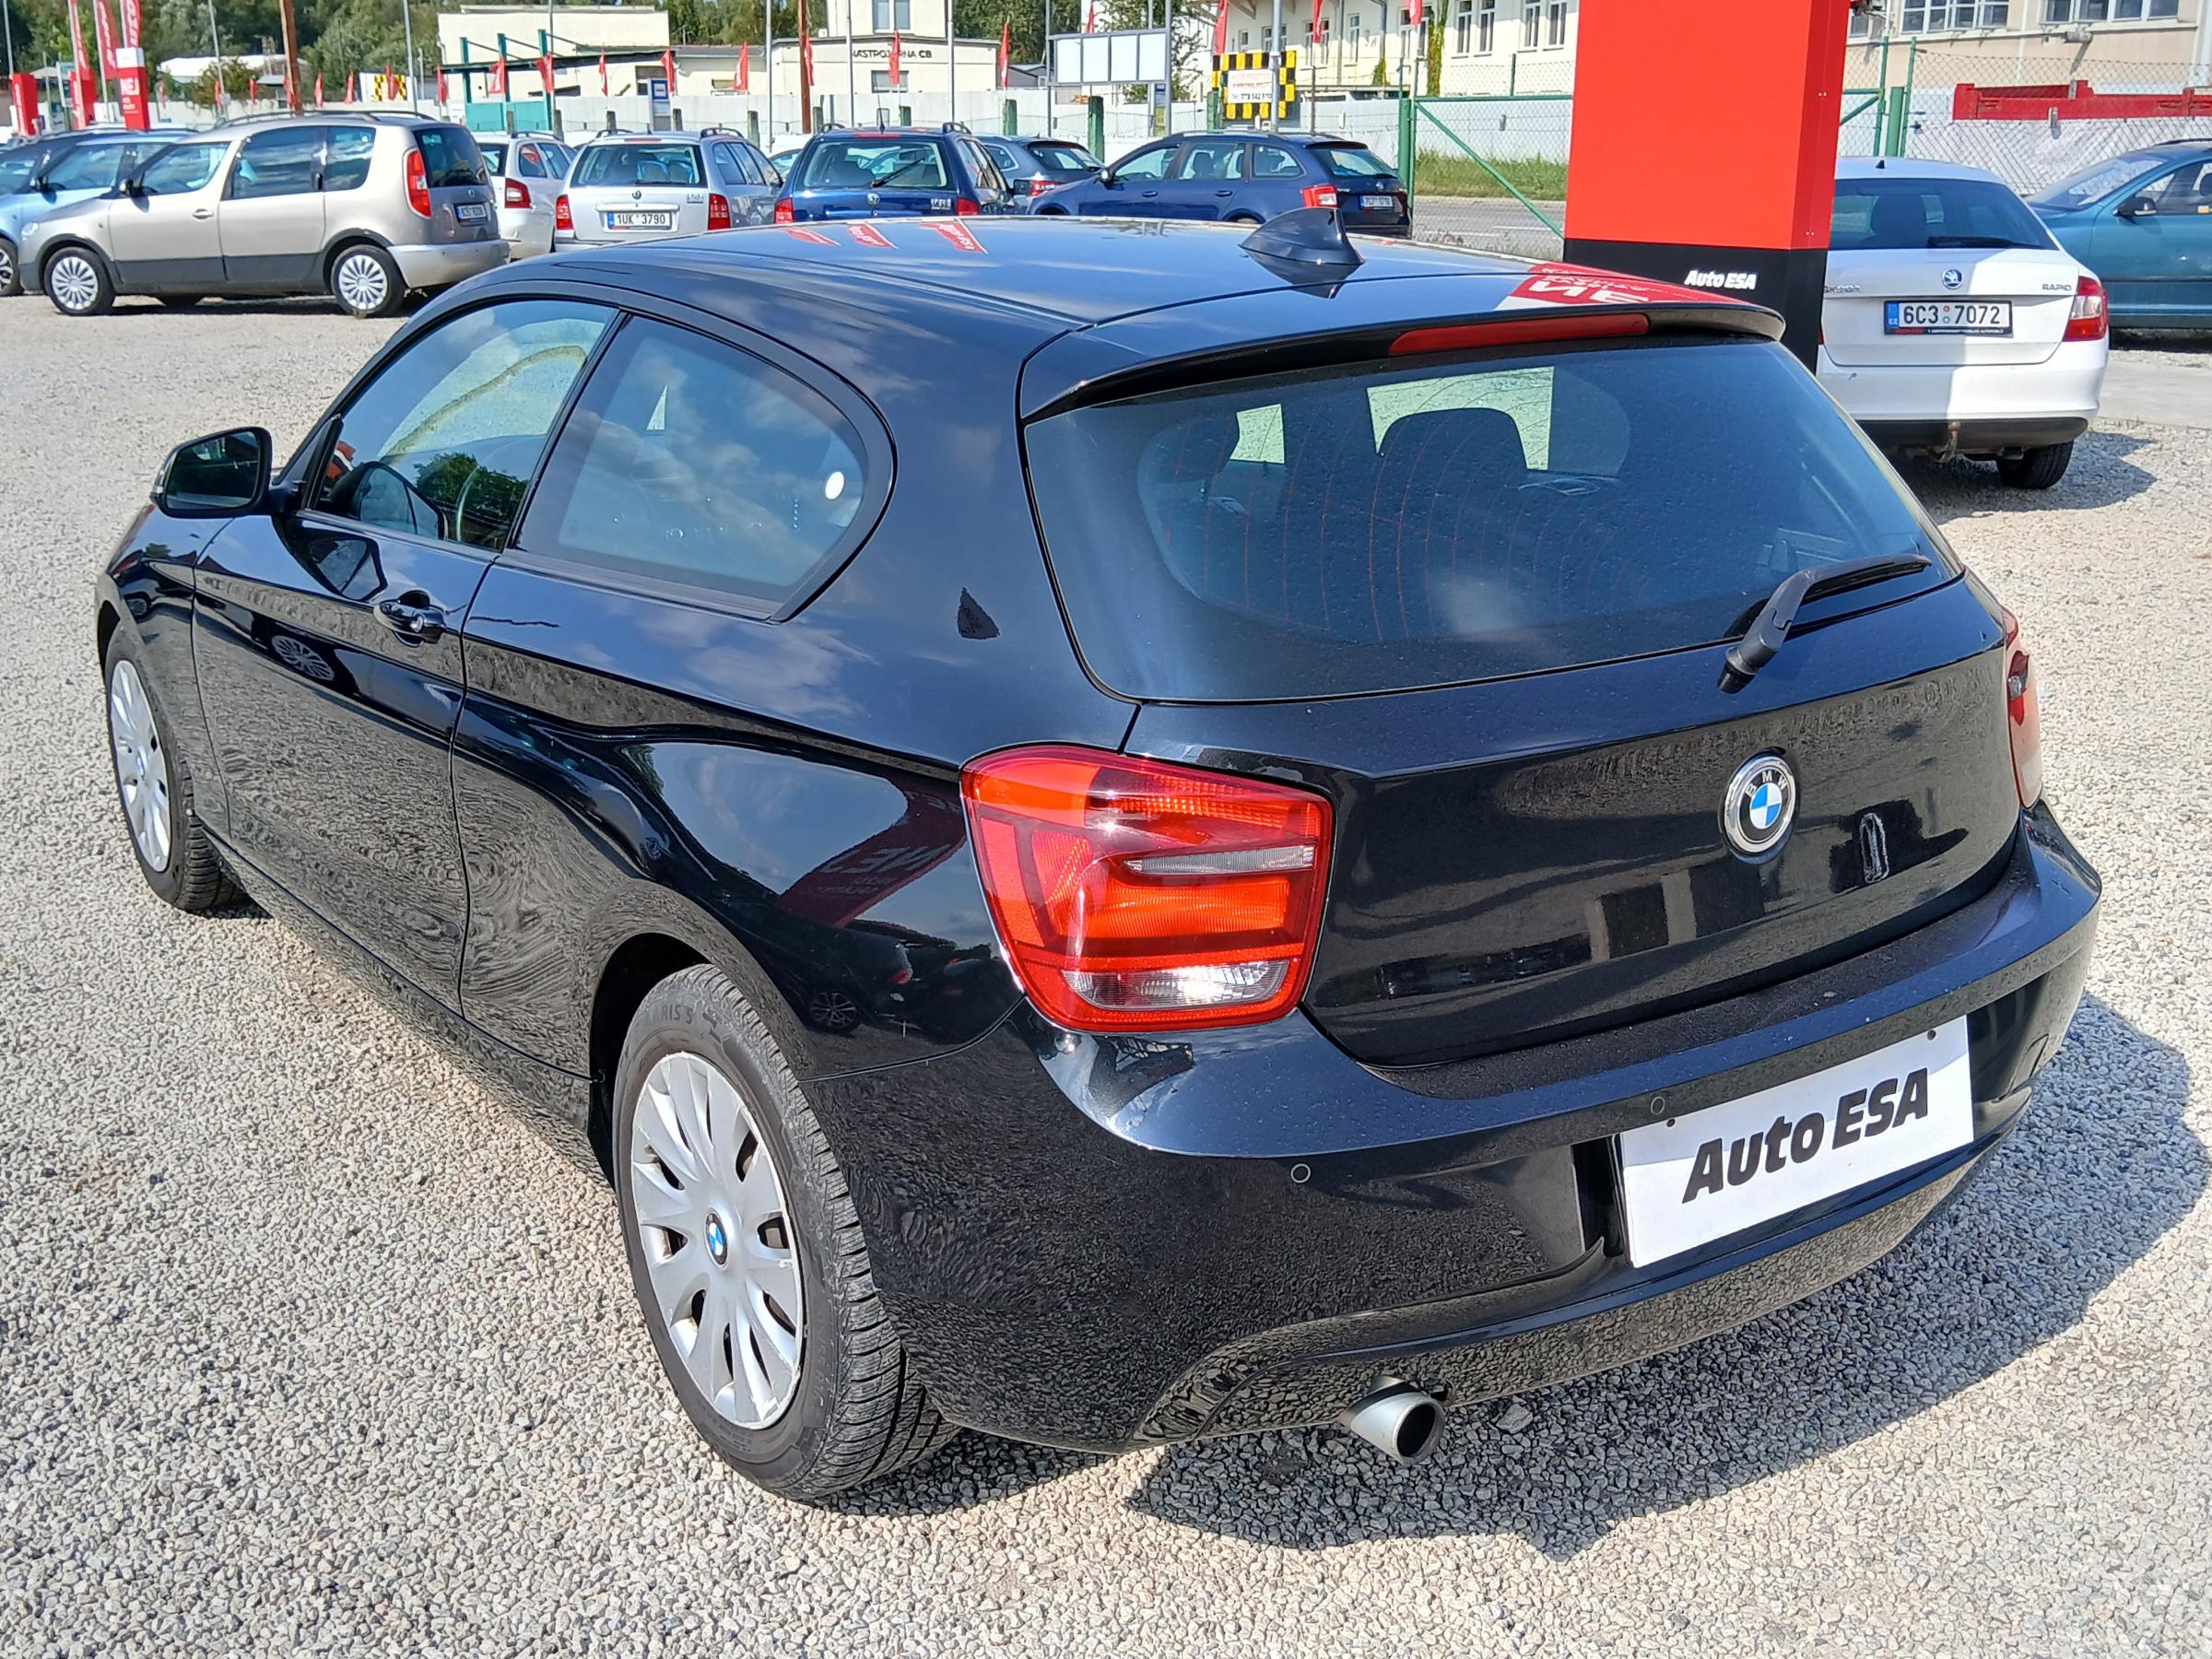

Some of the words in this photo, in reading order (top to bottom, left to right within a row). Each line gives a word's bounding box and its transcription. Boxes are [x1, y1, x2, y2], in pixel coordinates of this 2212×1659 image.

[617, 214, 634, 225] 1UK
[641, 214, 665, 225] 3790
[1683, 270, 1725, 288] Auto
[1724, 272, 1757, 290] ESA
[1903, 305, 1939, 324] 6C3
[1954, 305, 2001, 324] 7072
[1744, 770, 1788, 798] BMW
[1682, 1112, 1825, 1204] Auto
[1831, 1066, 1929, 1150] ESA
